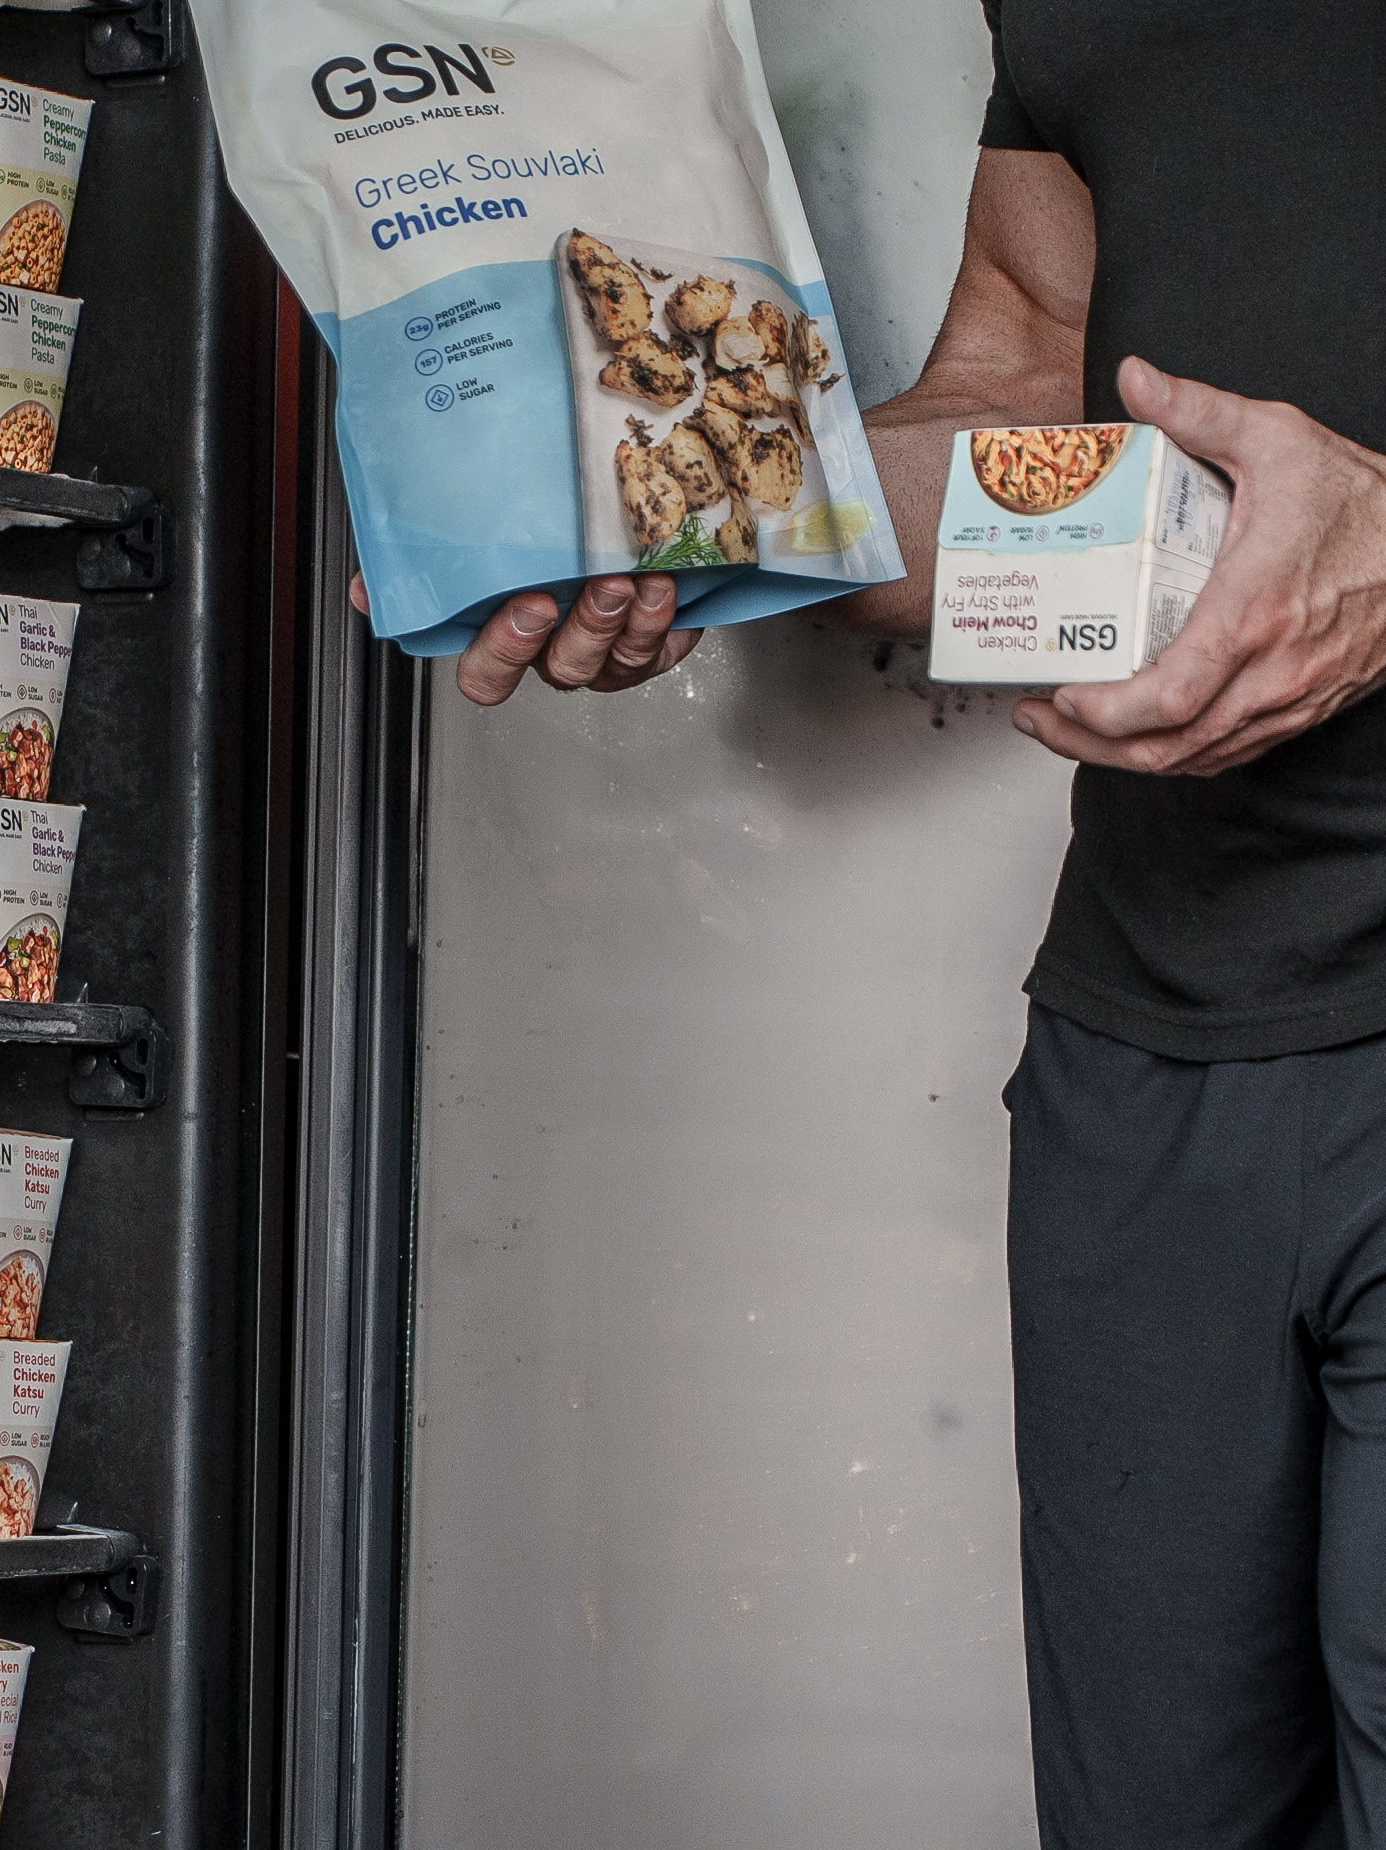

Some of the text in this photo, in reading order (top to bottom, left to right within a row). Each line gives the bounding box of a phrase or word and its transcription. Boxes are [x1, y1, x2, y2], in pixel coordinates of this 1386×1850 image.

[311, 42, 496, 120] GSN
[334, 104, 505, 144] DELICIOUS. MADE EASY.
[355, 148, 605, 208] Greek Souvlaki
[371, 197, 528, 251] Chicken
[435, 299, 477, 322] PROTEIN
[437, 301, 501, 331] PER SERVING
[409, 323, 429, 335] 23g
[444, 332, 494, 354] CALORIES
[447, 338, 513, 365] PER SERVING
[420, 356, 437, 368] 157
[456, 377, 477, 391] LOW
[459, 384, 495, 401] SUGAR
[957, 570, 1039, 590] Vegetables
[942, 594, 964, 611] Fry
[1003, 595, 1035, 611] with
[953, 616, 1037, 632] Chow Mein
[978, 636, 1037, 652] Chicken
[1059, 623, 1118, 651] GSN
[13, 1351, 56, 1367] Breaded
[13, 1368, 56, 1384] Chicken
[13, 1385, 45, 1399] Katsu
[12, 1401, 40, 1418] Curry
